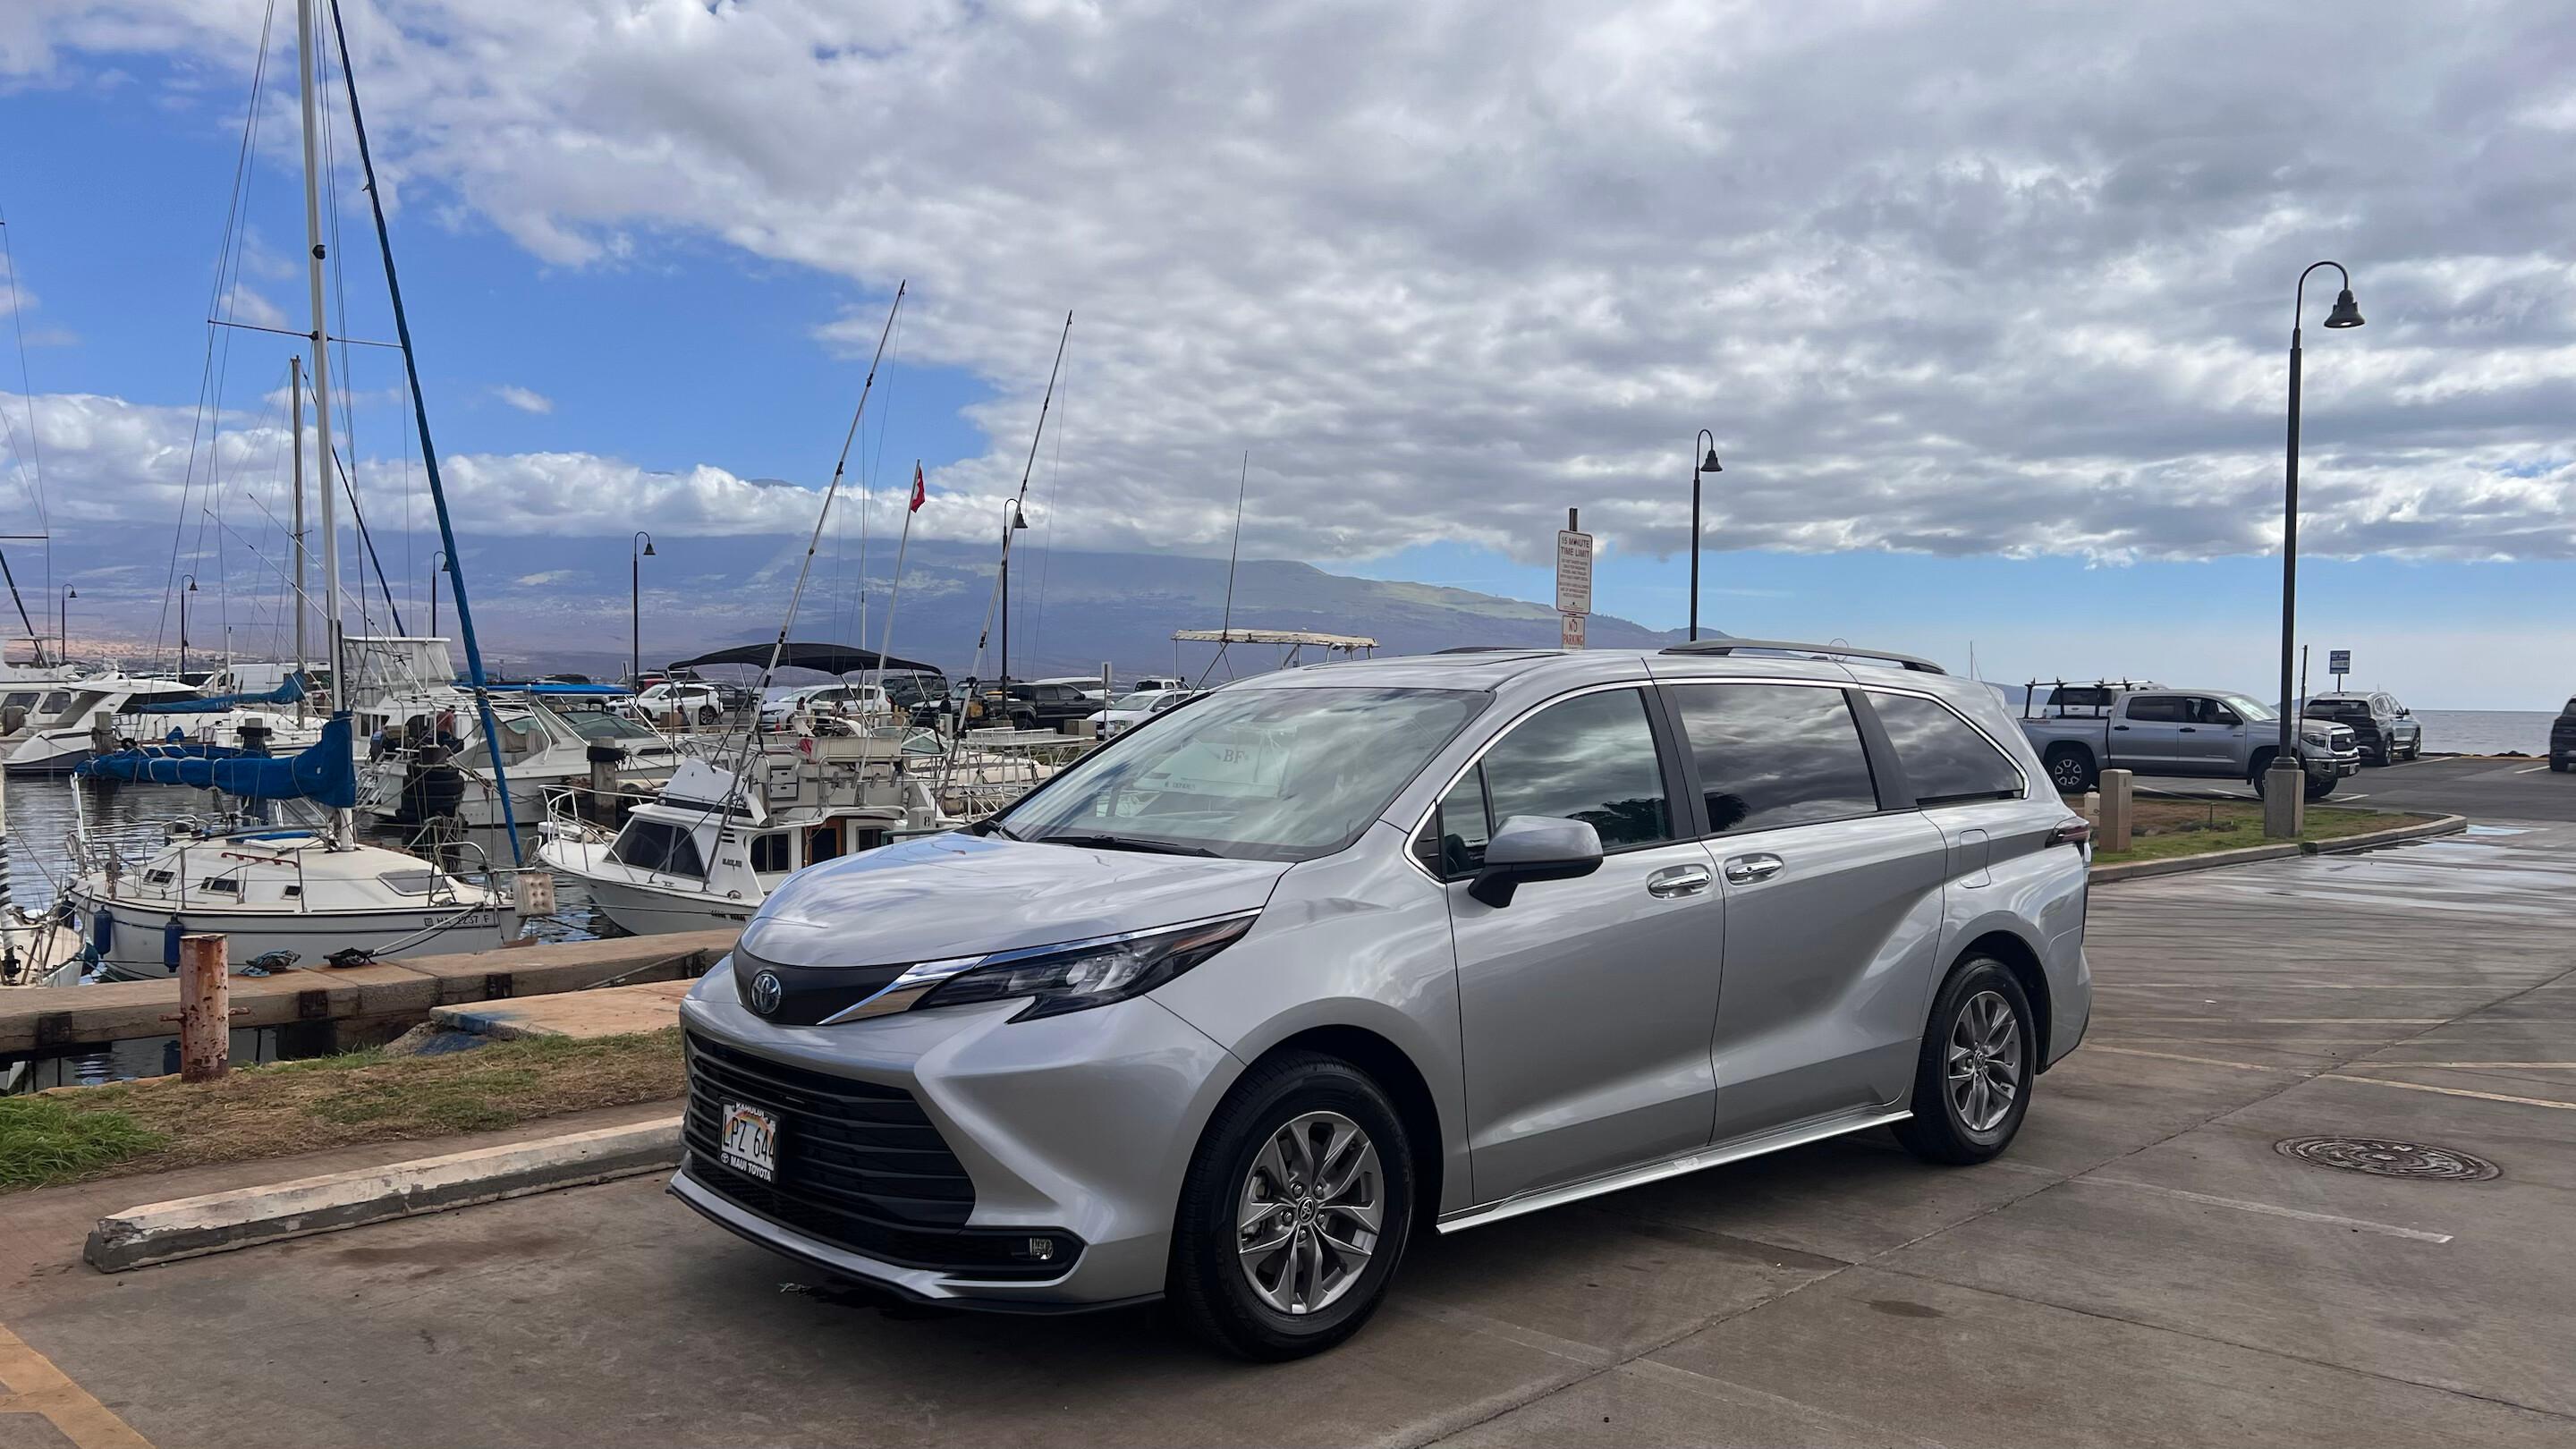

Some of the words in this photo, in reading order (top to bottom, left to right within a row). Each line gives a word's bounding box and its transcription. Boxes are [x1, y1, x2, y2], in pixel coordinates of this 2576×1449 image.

[1562, 537, 1568, 545] 15
[1569, 537, 1590, 548] MINUTE
[1561, 547, 1574, 556] TIME
[1575, 548, 1589, 559] LIMIT
[1563, 633, 1583, 645] PARKING
[484, 914, 490, 923] F
[723, 1114, 748, 1153] LPZ
[753, 1127, 776, 1165] 644
[730, 1156, 748, 1172] MAUI
[748, 1163, 772, 1182] TOYOTA
